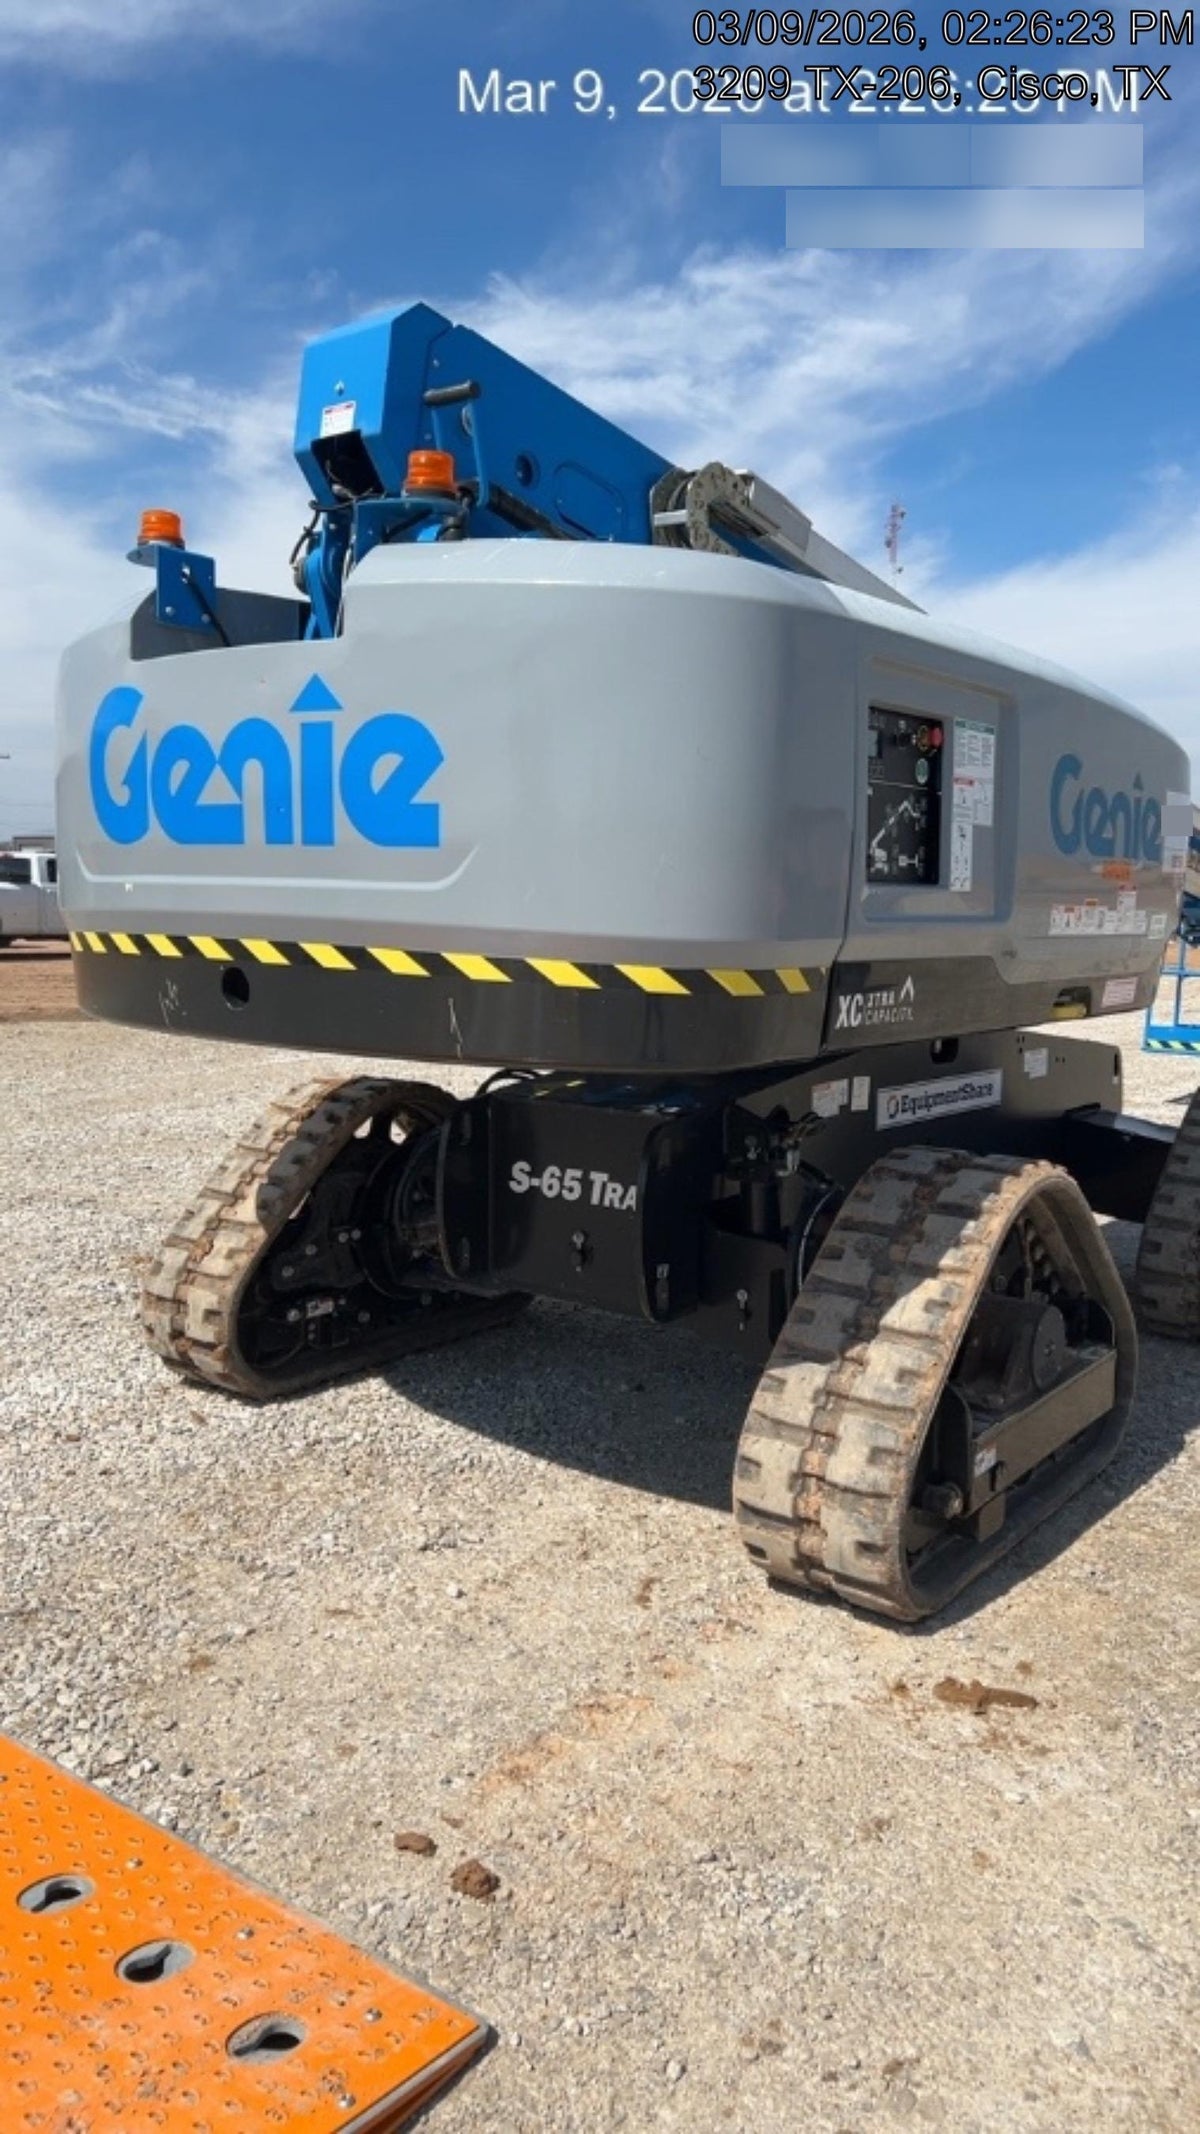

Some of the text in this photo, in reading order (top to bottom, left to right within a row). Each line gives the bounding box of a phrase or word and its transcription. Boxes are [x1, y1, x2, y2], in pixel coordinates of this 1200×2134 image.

[89, 673, 445, 848] Genie
[1050, 753, 1164, 862] Genie
[834, 992, 864, 1030] XC
[900, 1082, 994, 1115] EquipmentShare
[509, 1160, 583, 1201] S-65
